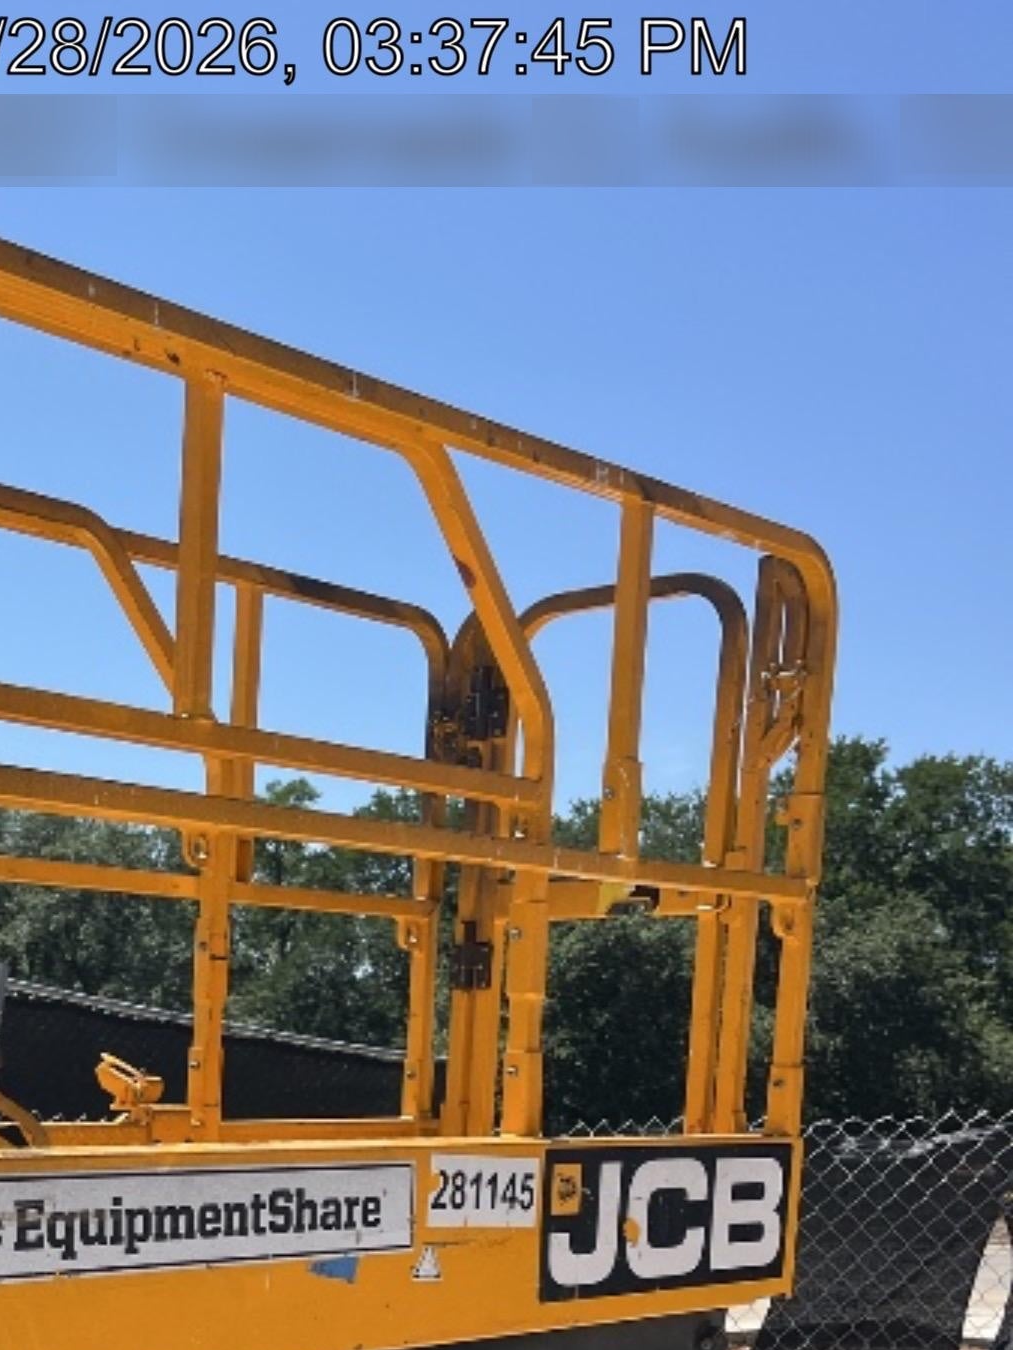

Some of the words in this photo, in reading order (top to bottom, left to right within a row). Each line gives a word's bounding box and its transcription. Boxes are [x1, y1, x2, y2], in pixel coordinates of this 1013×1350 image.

[14, 1187, 382, 1260] EquipmentShare
[431, 1170, 535, 1210] 281145
[548, 1156, 785, 1287] JCB
